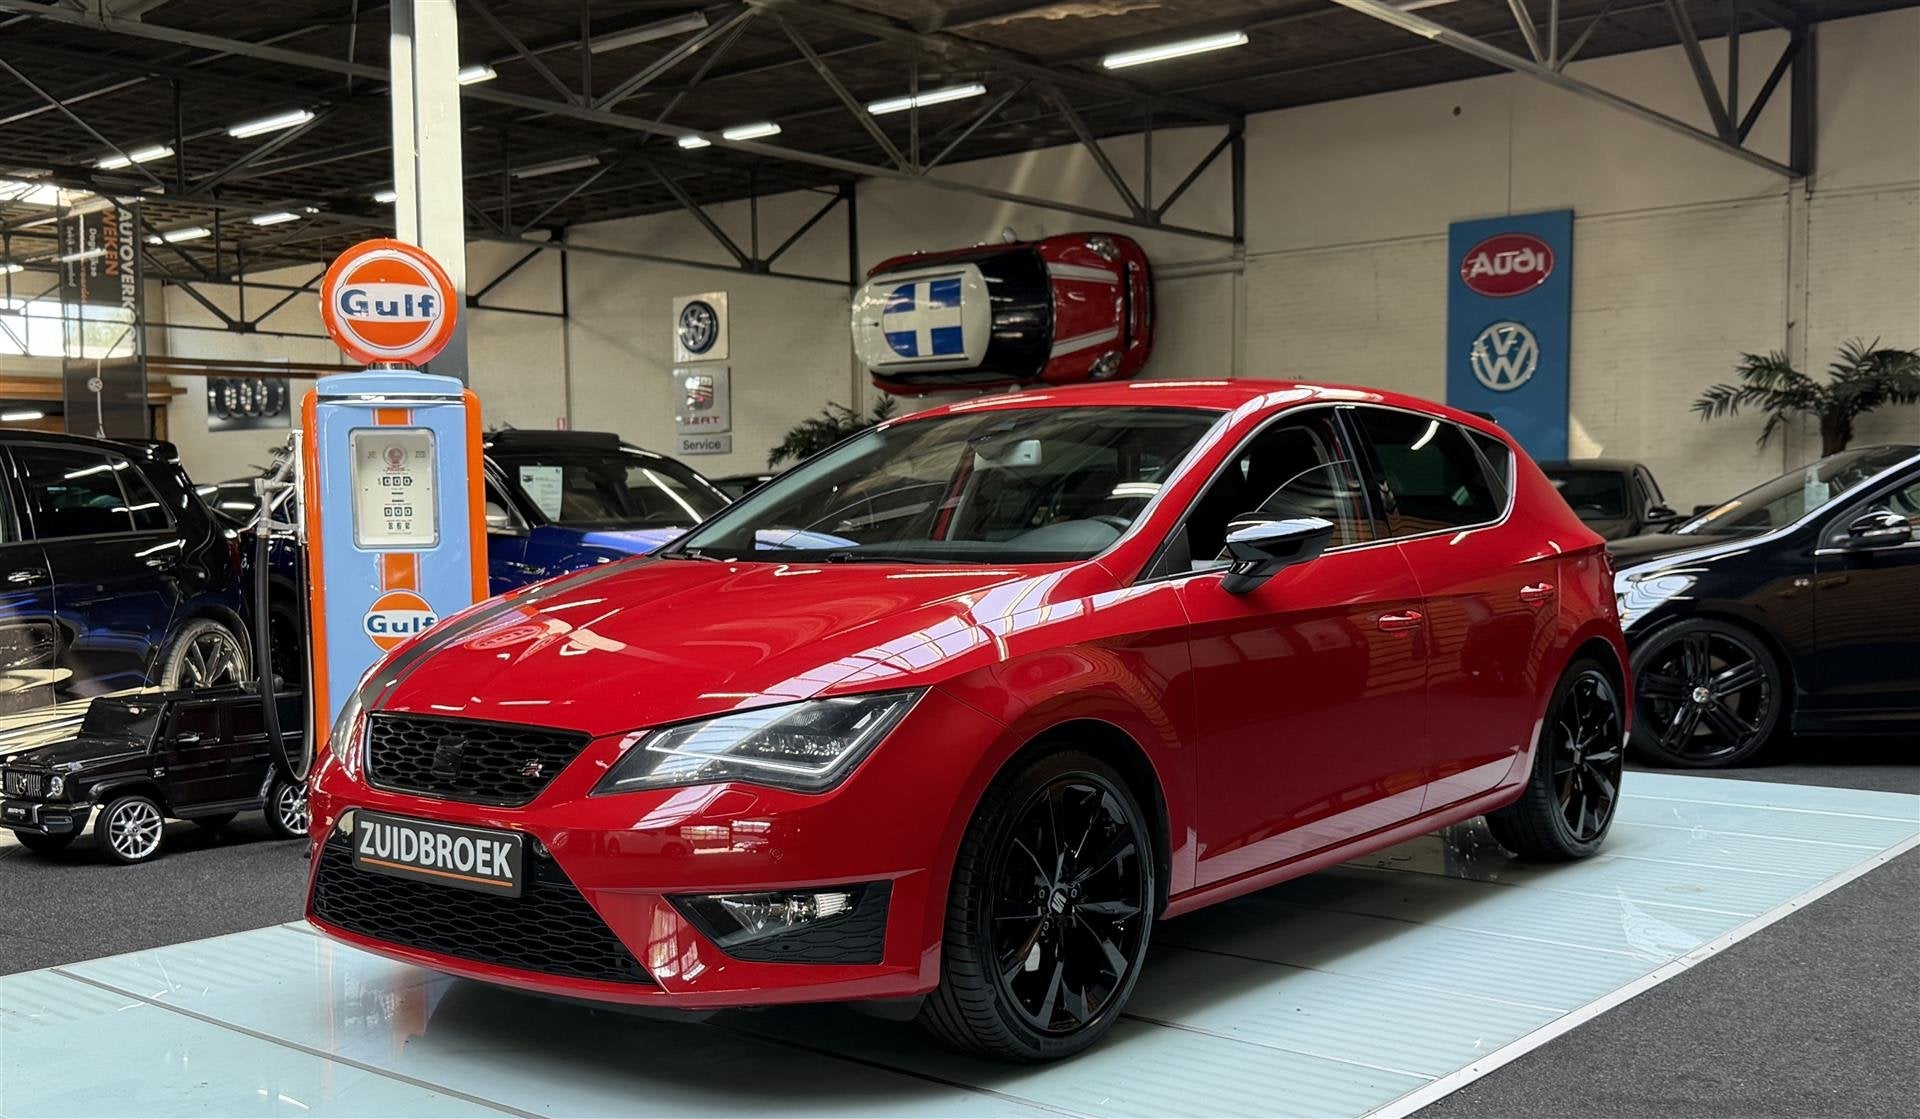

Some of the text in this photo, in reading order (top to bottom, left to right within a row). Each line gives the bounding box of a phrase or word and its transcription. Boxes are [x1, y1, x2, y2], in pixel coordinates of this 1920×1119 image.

[102, 208, 119, 277] WEKEN
[340, 289, 435, 317] Gulf
[682, 415, 721, 426] SEAT
[683, 439, 721, 450] Service
[367, 614, 435, 633] Gulf
[359, 820, 513, 879] ZUIDBROEK
